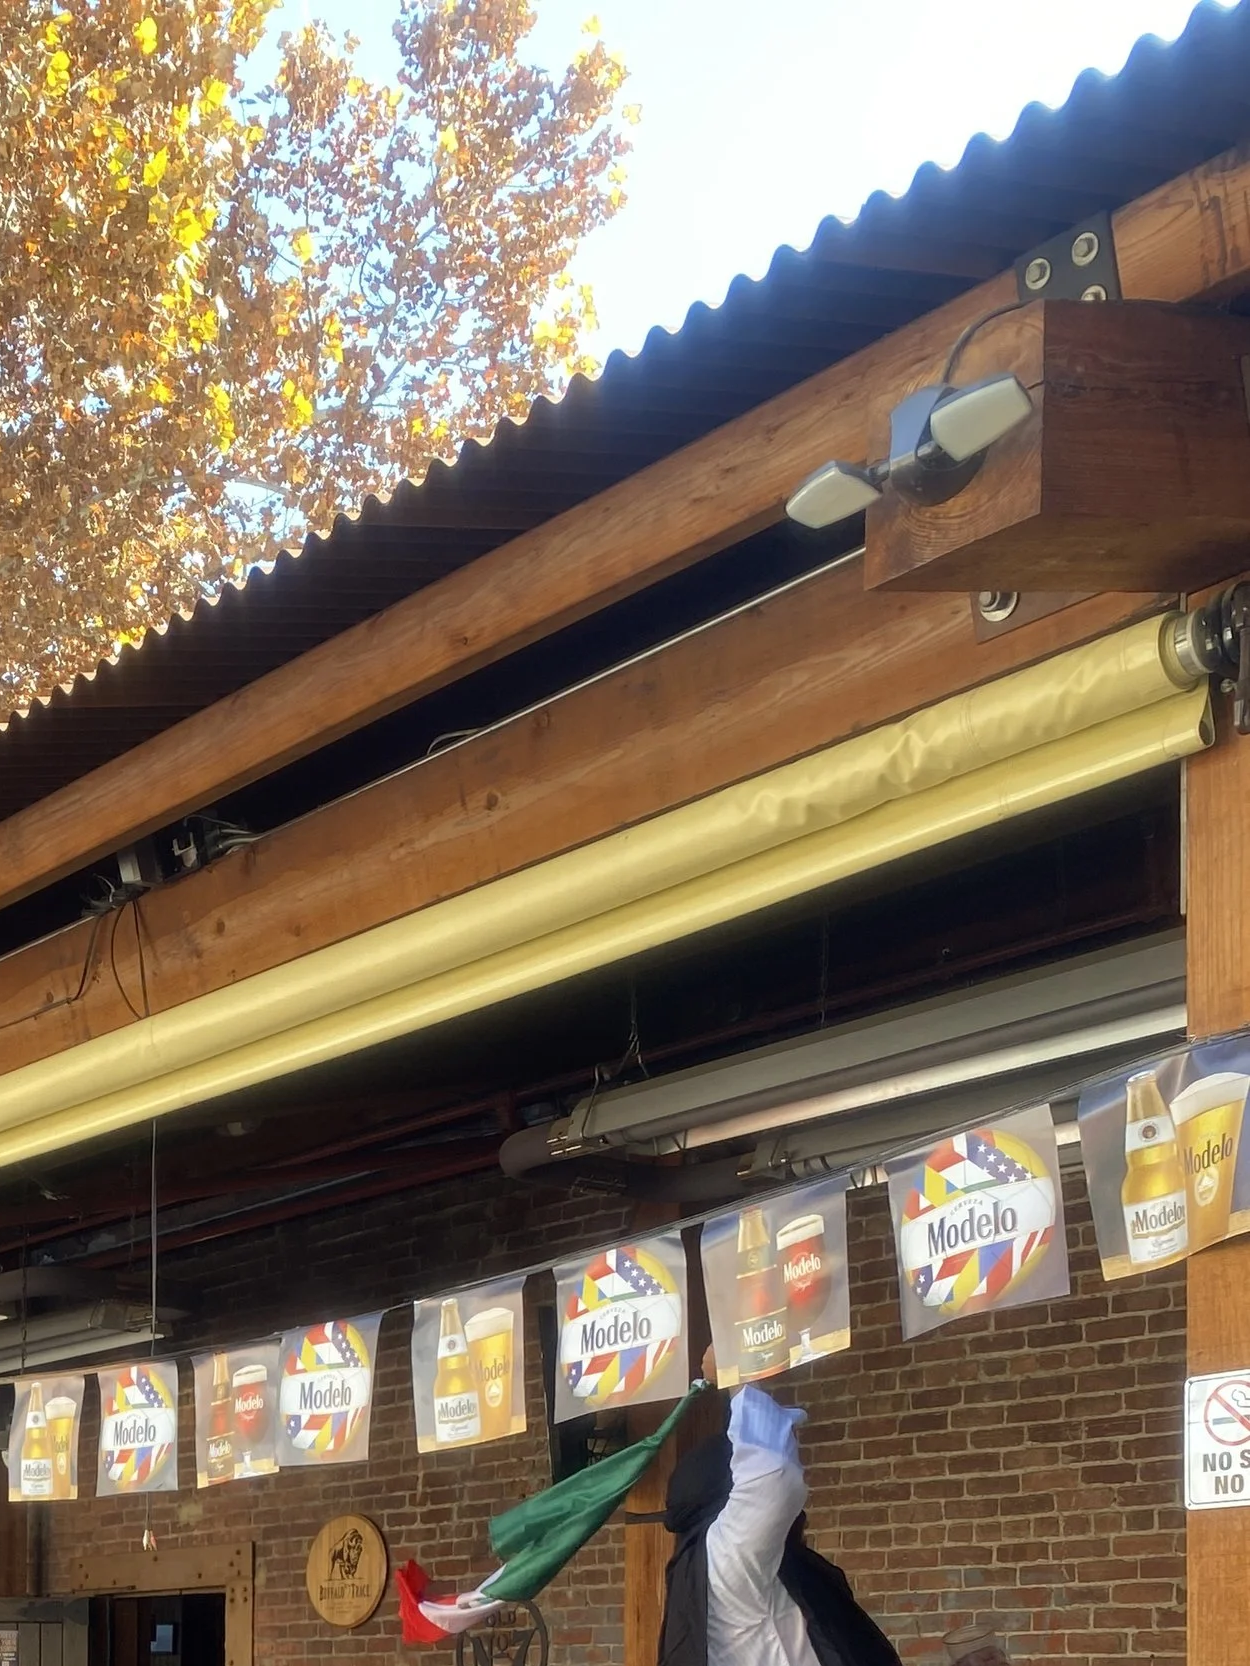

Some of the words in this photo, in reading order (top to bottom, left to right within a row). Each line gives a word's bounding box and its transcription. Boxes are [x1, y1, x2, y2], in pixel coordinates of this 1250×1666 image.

[1184, 1133, 1233, 1175] Modelo
[928, 1200, 1017, 1258] Modelo
[1135, 1201, 1185, 1233] Modelo
[783, 1253, 821, 1284] Modelo
[581, 1310, 652, 1356] Modelo
[742, 1320, 783, 1347] Modelo
[235, 1394, 264, 1413] Modelo
[300, 1381, 351, 1411] Modelo
[439, 1398, 476, 1420] Modelo
[114, 1418, 157, 1447] Modelo
[209, 1441, 232, 1458] Modelo
[1203, 1452, 1232, 1472] NO
[1214, 1474, 1244, 1494] NO
[484, 1609, 517, 1627] OLD
